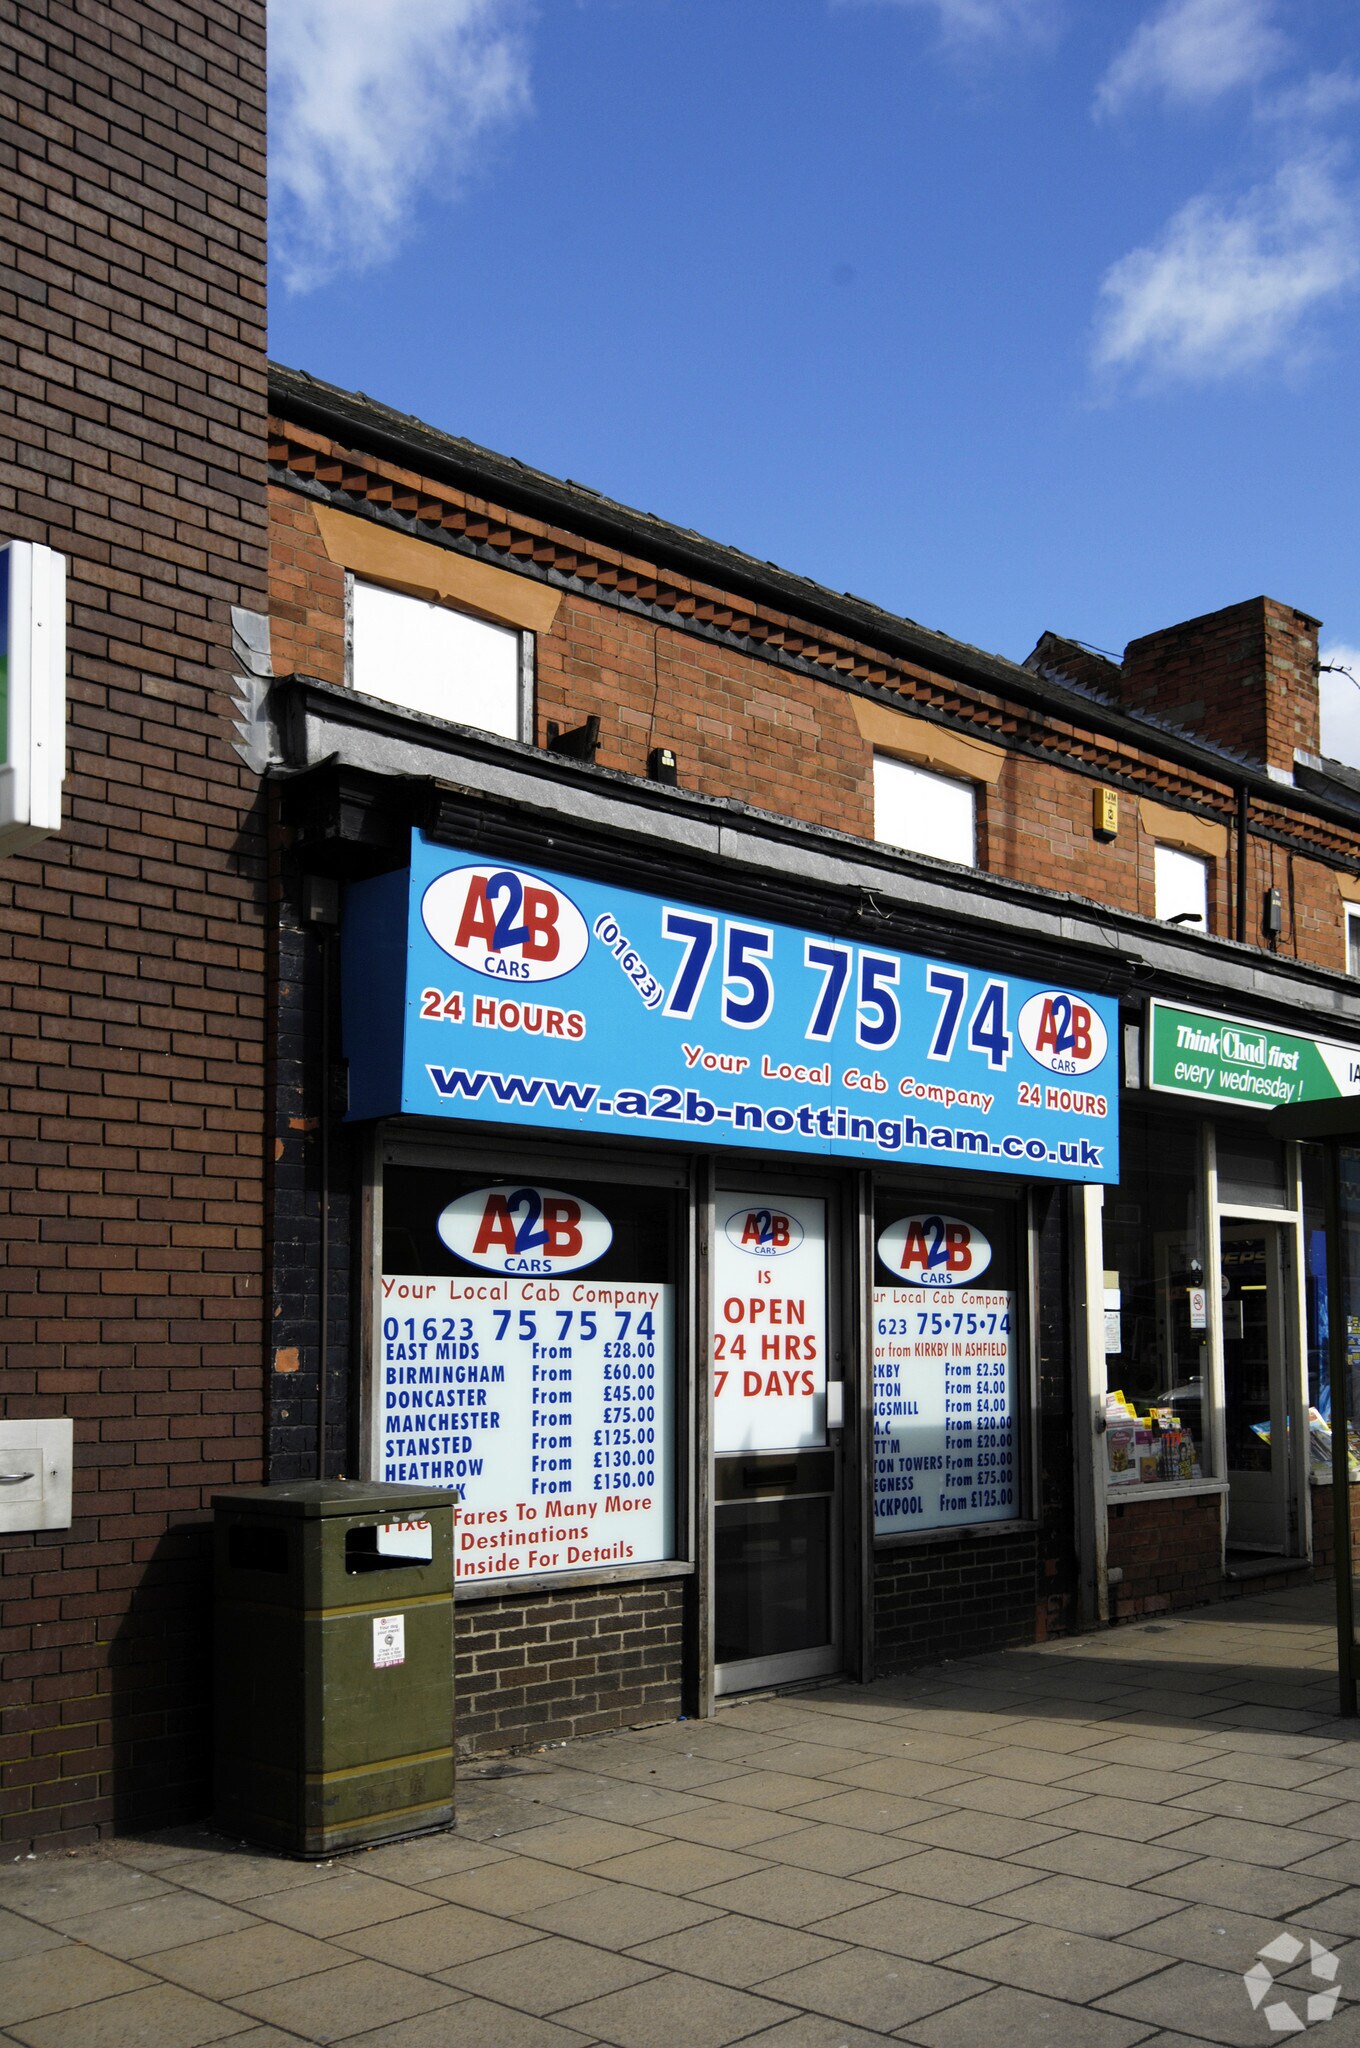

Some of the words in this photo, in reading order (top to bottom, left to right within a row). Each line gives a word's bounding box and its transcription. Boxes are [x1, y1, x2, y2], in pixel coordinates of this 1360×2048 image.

[454, 871, 560, 962] A2B
[484, 956, 530, 979] CARS
[596, 914, 662, 1008] (01623)
[665, 910, 772, 1026] 75
[806, 941, 899, 1047] 75
[928, 968, 1010, 1068] 74
[422, 990, 462, 1020] 24
[476, 999, 584, 1039] HOURS
[1036, 994, 1092, 1060] A2B
[1176, 1025, 1220, 1055] Think
[1222, 1031, 1266, 1065] Chad
[1268, 1045, 1300, 1071] first
[1051, 1057, 1076, 1073] CARS
[684, 1045, 748, 1073] Your
[763, 1057, 829, 1084] Local
[844, 1070, 887, 1091] Cab
[900, 1078, 993, 1112] Company
[1174, 1061, 1215, 1089] every
[1219, 1070, 1295, 1104] wednesday
[1019, 1084, 1040, 1106] 24
[1047, 1088, 1107, 1116] HOURS
[428, 1065, 1101, 1167] www.a2b-nottingham.co.uk
[472, 1188, 583, 1258] A2B
[741, 1210, 790, 1247] A2B
[754, 1246, 776, 1255] CARS
[900, 1216, 972, 1271] A2B
[504, 1258, 553, 1272] CARS
[758, 1269, 772, 1284] IS
[920, 1272, 953, 1284] CARS
[382, 1278, 436, 1299] Your
[450, 1280, 508, 1301] Local
[521, 1282, 560, 1301] Cab
[572, 1284, 659, 1309] Company
[894, 1289, 926, 1304] Local
[933, 1291, 954, 1305] Cab
[961, 1292, 1011, 1309] Company
[723, 1297, 805, 1325] OPEN
[383, 1317, 474, 1341] 01623
[492, 1309, 537, 1341] 75
[555, 1310, 597, 1341] 75
[614, 1311, 656, 1341] 74
[878, 1318, 907, 1335] 623
[386, 1342, 428, 1361] EAST
[436, 1342, 480, 1360] MIDS
[532, 1342, 573, 1359] From
[603, 1342, 655, 1358] £28.00
[714, 1334, 747, 1361] 24
[761, 1334, 817, 1361] HRS
[889, 1342, 910, 1357] from
[914, 1342, 949, 1357] KIRKBY
[952, 1343, 962, 1357] IN
[965, 1343, 1007, 1357] ASHFIELD
[386, 1365, 505, 1384] BIRMINGHAM
[532, 1365, 573, 1382] From
[603, 1363, 655, 1380] £60.00
[945, 1362, 971, 1376] From
[976, 1363, 1005, 1376] £2.50
[386, 1389, 487, 1408] DONCASTER
[532, 1387, 573, 1404] From
[603, 1385, 655, 1402] £45.00
[714, 1370, 729, 1397] 7
[743, 1370, 815, 1397] DAYS
[945, 1381, 971, 1394] From
[976, 1381, 1005, 1394] £4.00
[945, 1399, 971, 1412] From
[977, 1398, 1005, 1412] £4.00
[386, 1411, 500, 1433] MANCHESTER
[532, 1410, 573, 1427] From
[603, 1406, 655, 1424] £75.00
[945, 1417, 972, 1431] From
[977, 1416, 1012, 1430] £20.00
[386, 1436, 472, 1458] STANSTED
[532, 1433, 573, 1450] From
[593, 1427, 655, 1446] £125.00
[945, 1435, 972, 1449] From
[977, 1434, 1012, 1448] £20.00
[386, 1458, 483, 1481] HEATHROW
[532, 1455, 573, 1473] From
[593, 1449, 655, 1468] £130.00
[899, 1455, 943, 1472] TOWERS
[946, 1455, 973, 1470] From
[977, 1452, 1012, 1467] £50.00
[532, 1478, 573, 1495] From
[593, 1470, 655, 1490] £150.00
[946, 1473, 973, 1488] From
[977, 1470, 1012, 1485] £75.00
[453, 1508, 508, 1527] Fares
[516, 1503, 537, 1521] To
[545, 1500, 598, 1519] Many
[605, 1495, 653, 1513] More
[940, 1494, 967, 1512] From
[971, 1488, 1013, 1508] £125.00
[461, 1525, 589, 1551] Destinations
[456, 1553, 520, 1576] Inside
[528, 1550, 559, 1569] For
[567, 1541, 634, 1564] Details
